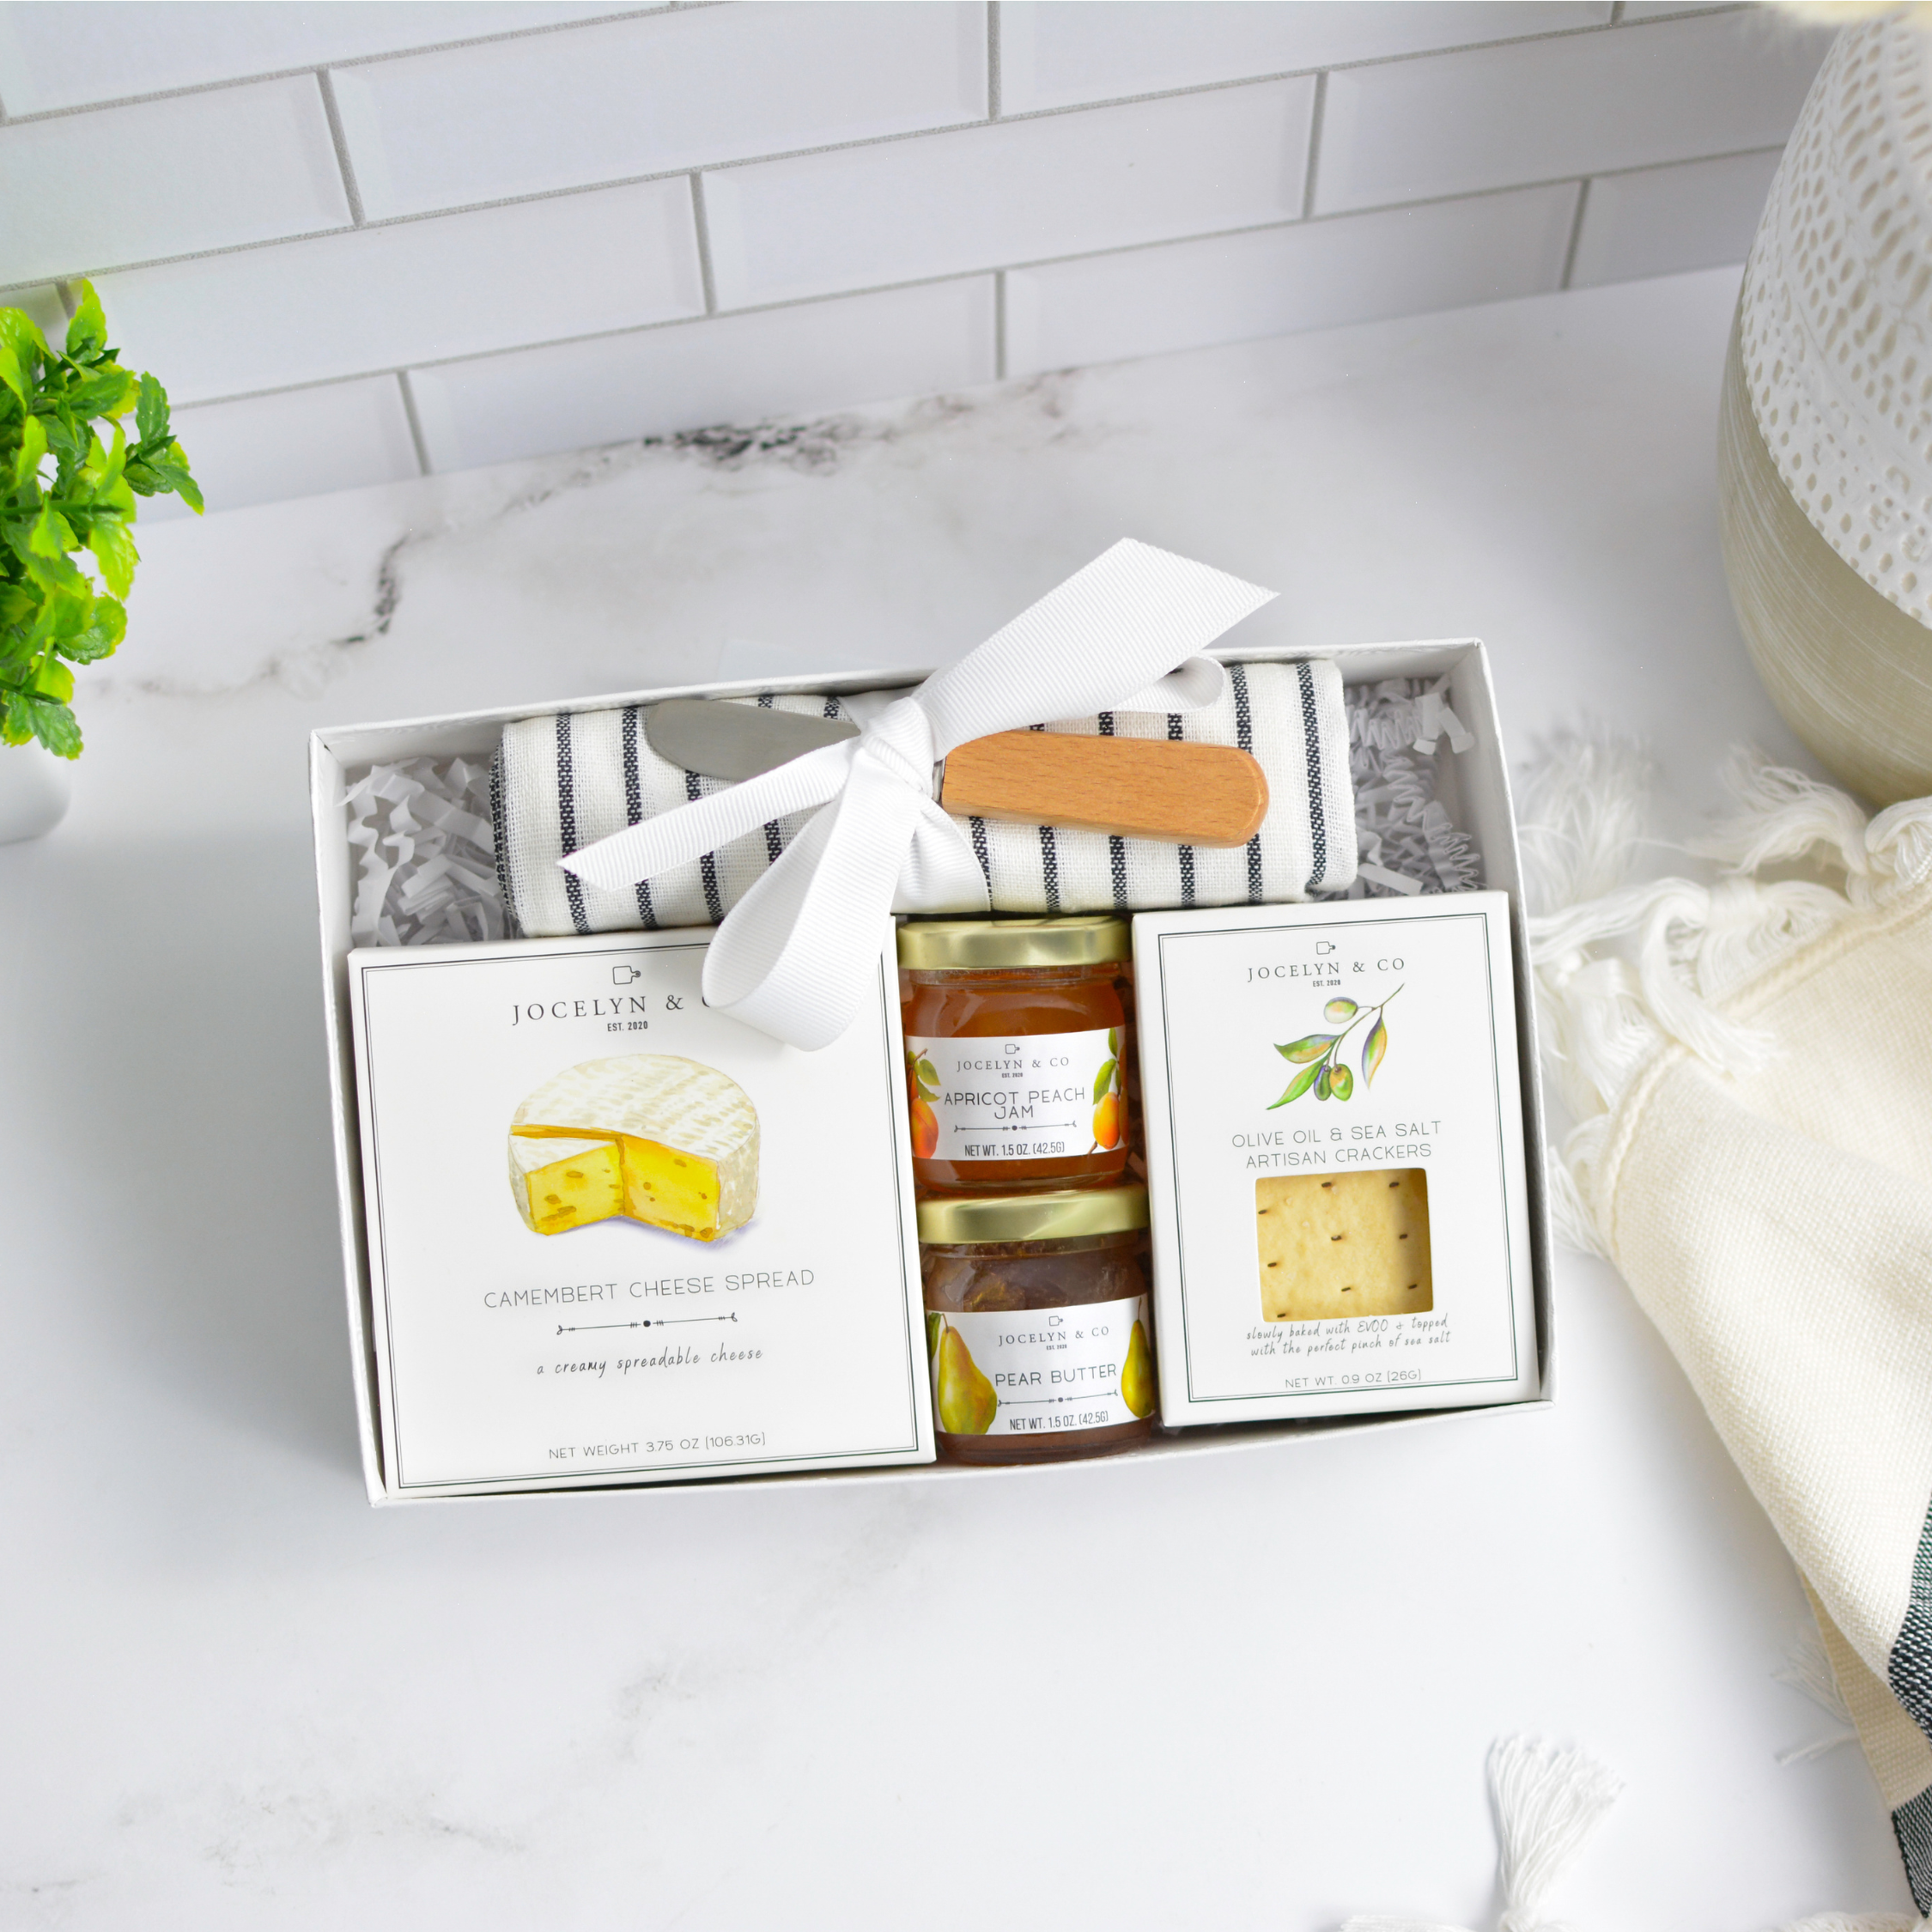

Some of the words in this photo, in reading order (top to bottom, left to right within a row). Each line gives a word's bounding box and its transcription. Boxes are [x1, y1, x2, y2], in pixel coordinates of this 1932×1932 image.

[1247, 962, 1340, 982] JOCELYN
[1352, 961, 1365, 972] &
[1377, 958, 1405, 971] CO
[512, 995, 647, 1026] JOCELYN
[665, 994, 683, 1011] &
[607, 1022, 624, 1032] EST.
[957, 1060, 1023, 1072] JOCELYN
[1050, 1057, 1069, 1066] CO
[945, 1091, 1018, 1106] APRICOT
[1029, 1087, 1084, 1103] PEACH
[994, 1105, 1034, 1119] JAM
[1231, 1132, 1285, 1147] OLIVE
[1293, 1130, 1321, 1144] OIL
[1330, 1128, 1342, 1141] &
[1351, 1125, 1386, 1140] SEA
[1394, 1121, 1441, 1137] SALT
[964, 1145, 981, 1157] NET
[982, 1145, 999, 1157] WT.
[1002, 1144, 1014, 1156] 1.5
[1017, 1143, 1030, 1155] OZ.
[1246, 1151, 1326, 1169] ARTISAN
[1335, 1144, 1431, 1163] CRACKERS
[483, 1284, 617, 1309] CAMEMBERT
[629, 1276, 714, 1298] CHEESE
[725, 1269, 815, 1291] SPREAD
[999, 1331, 1066, 1346] JOCELYN
[1092, 1327, 1109, 1337] CO
[1246, 1326, 1283, 1343] slowly
[1289, 1322, 1320, 1338] baked
[1326, 1320, 1351, 1334] with
[1357, 1319, 1388, 1333] EVOO
[1412, 1313, 1449, 1332] topped
[1251, 1341, 1276, 1356] with
[1283, 1340, 1301, 1354] the
[1307, 1338, 1346, 1357] perfect
[1352, 1337, 1382, 1352] pinch
[1388, 1334, 1402, 1347] of
[1428, 1331, 1451, 1344] salt
[537, 1364, 544, 1375] a
[555, 1358, 606, 1378] creamy
[617, 1346, 701, 1374] spreadable
[710, 1342, 763, 1363] cheese
[995, 1372, 1042, 1387] PEAR
[1051, 1364, 1116, 1383] BUTTER
[1285, 1377, 1309, 1388] NET
[1315, 1376, 1337, 1387] WT.
[1341, 1375, 1359, 1385] 0.9
[1365, 1373, 1382, 1382] OZ
[1010, 1419, 1026, 1431] NET
[1029, 1418, 1045, 1429] WT.
[1048, 1417, 1061, 1428] 1.5
[1064, 1415, 1077, 1427] OZ.
[549, 1447, 575, 1459] NET
[583, 1442, 639, 1458] WEIGHT
[646, 1440, 674, 1453] 3.75
[679, 1437, 700, 1450] OZ
